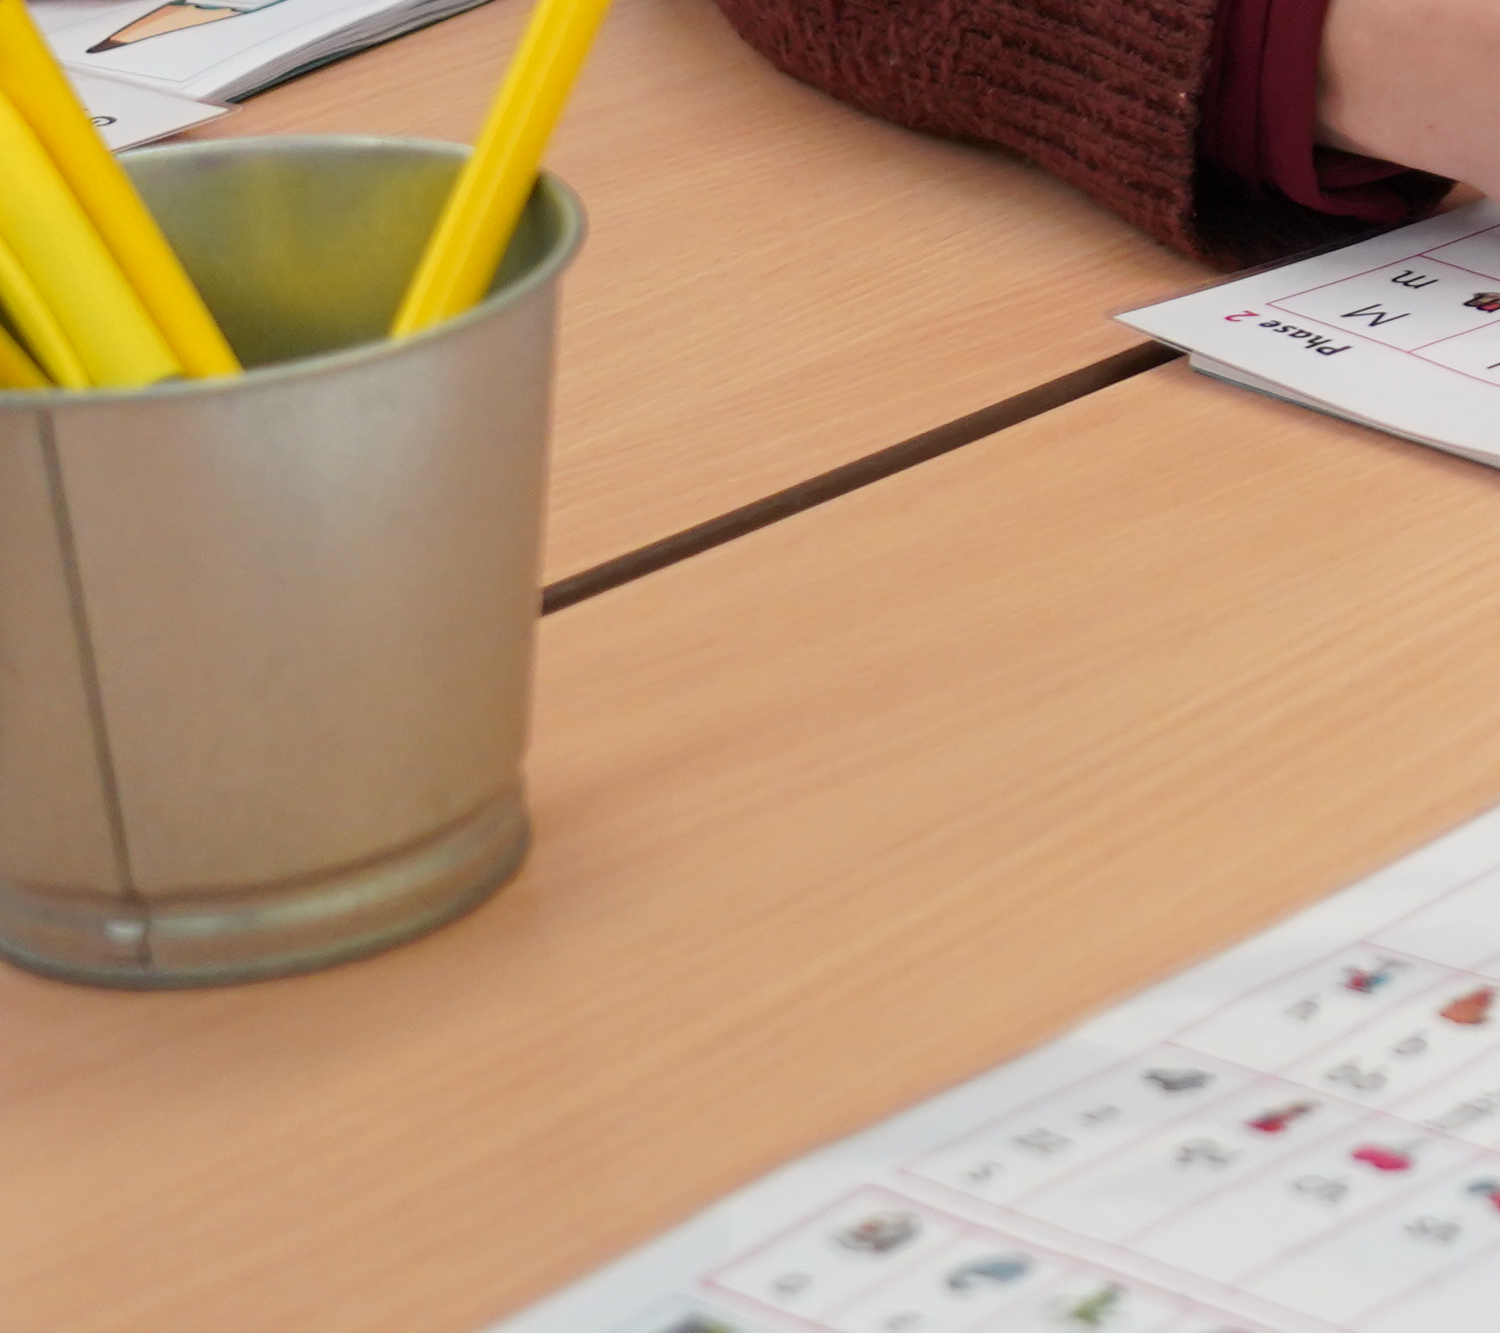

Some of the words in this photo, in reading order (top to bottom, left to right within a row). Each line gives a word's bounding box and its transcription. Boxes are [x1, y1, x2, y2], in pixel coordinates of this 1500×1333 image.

[1389, 269, 1440, 291] m
[1223, 308, 1260, 324] 2
[1339, 302, 1412, 328] M
[1257, 318, 1354, 358] Phase
